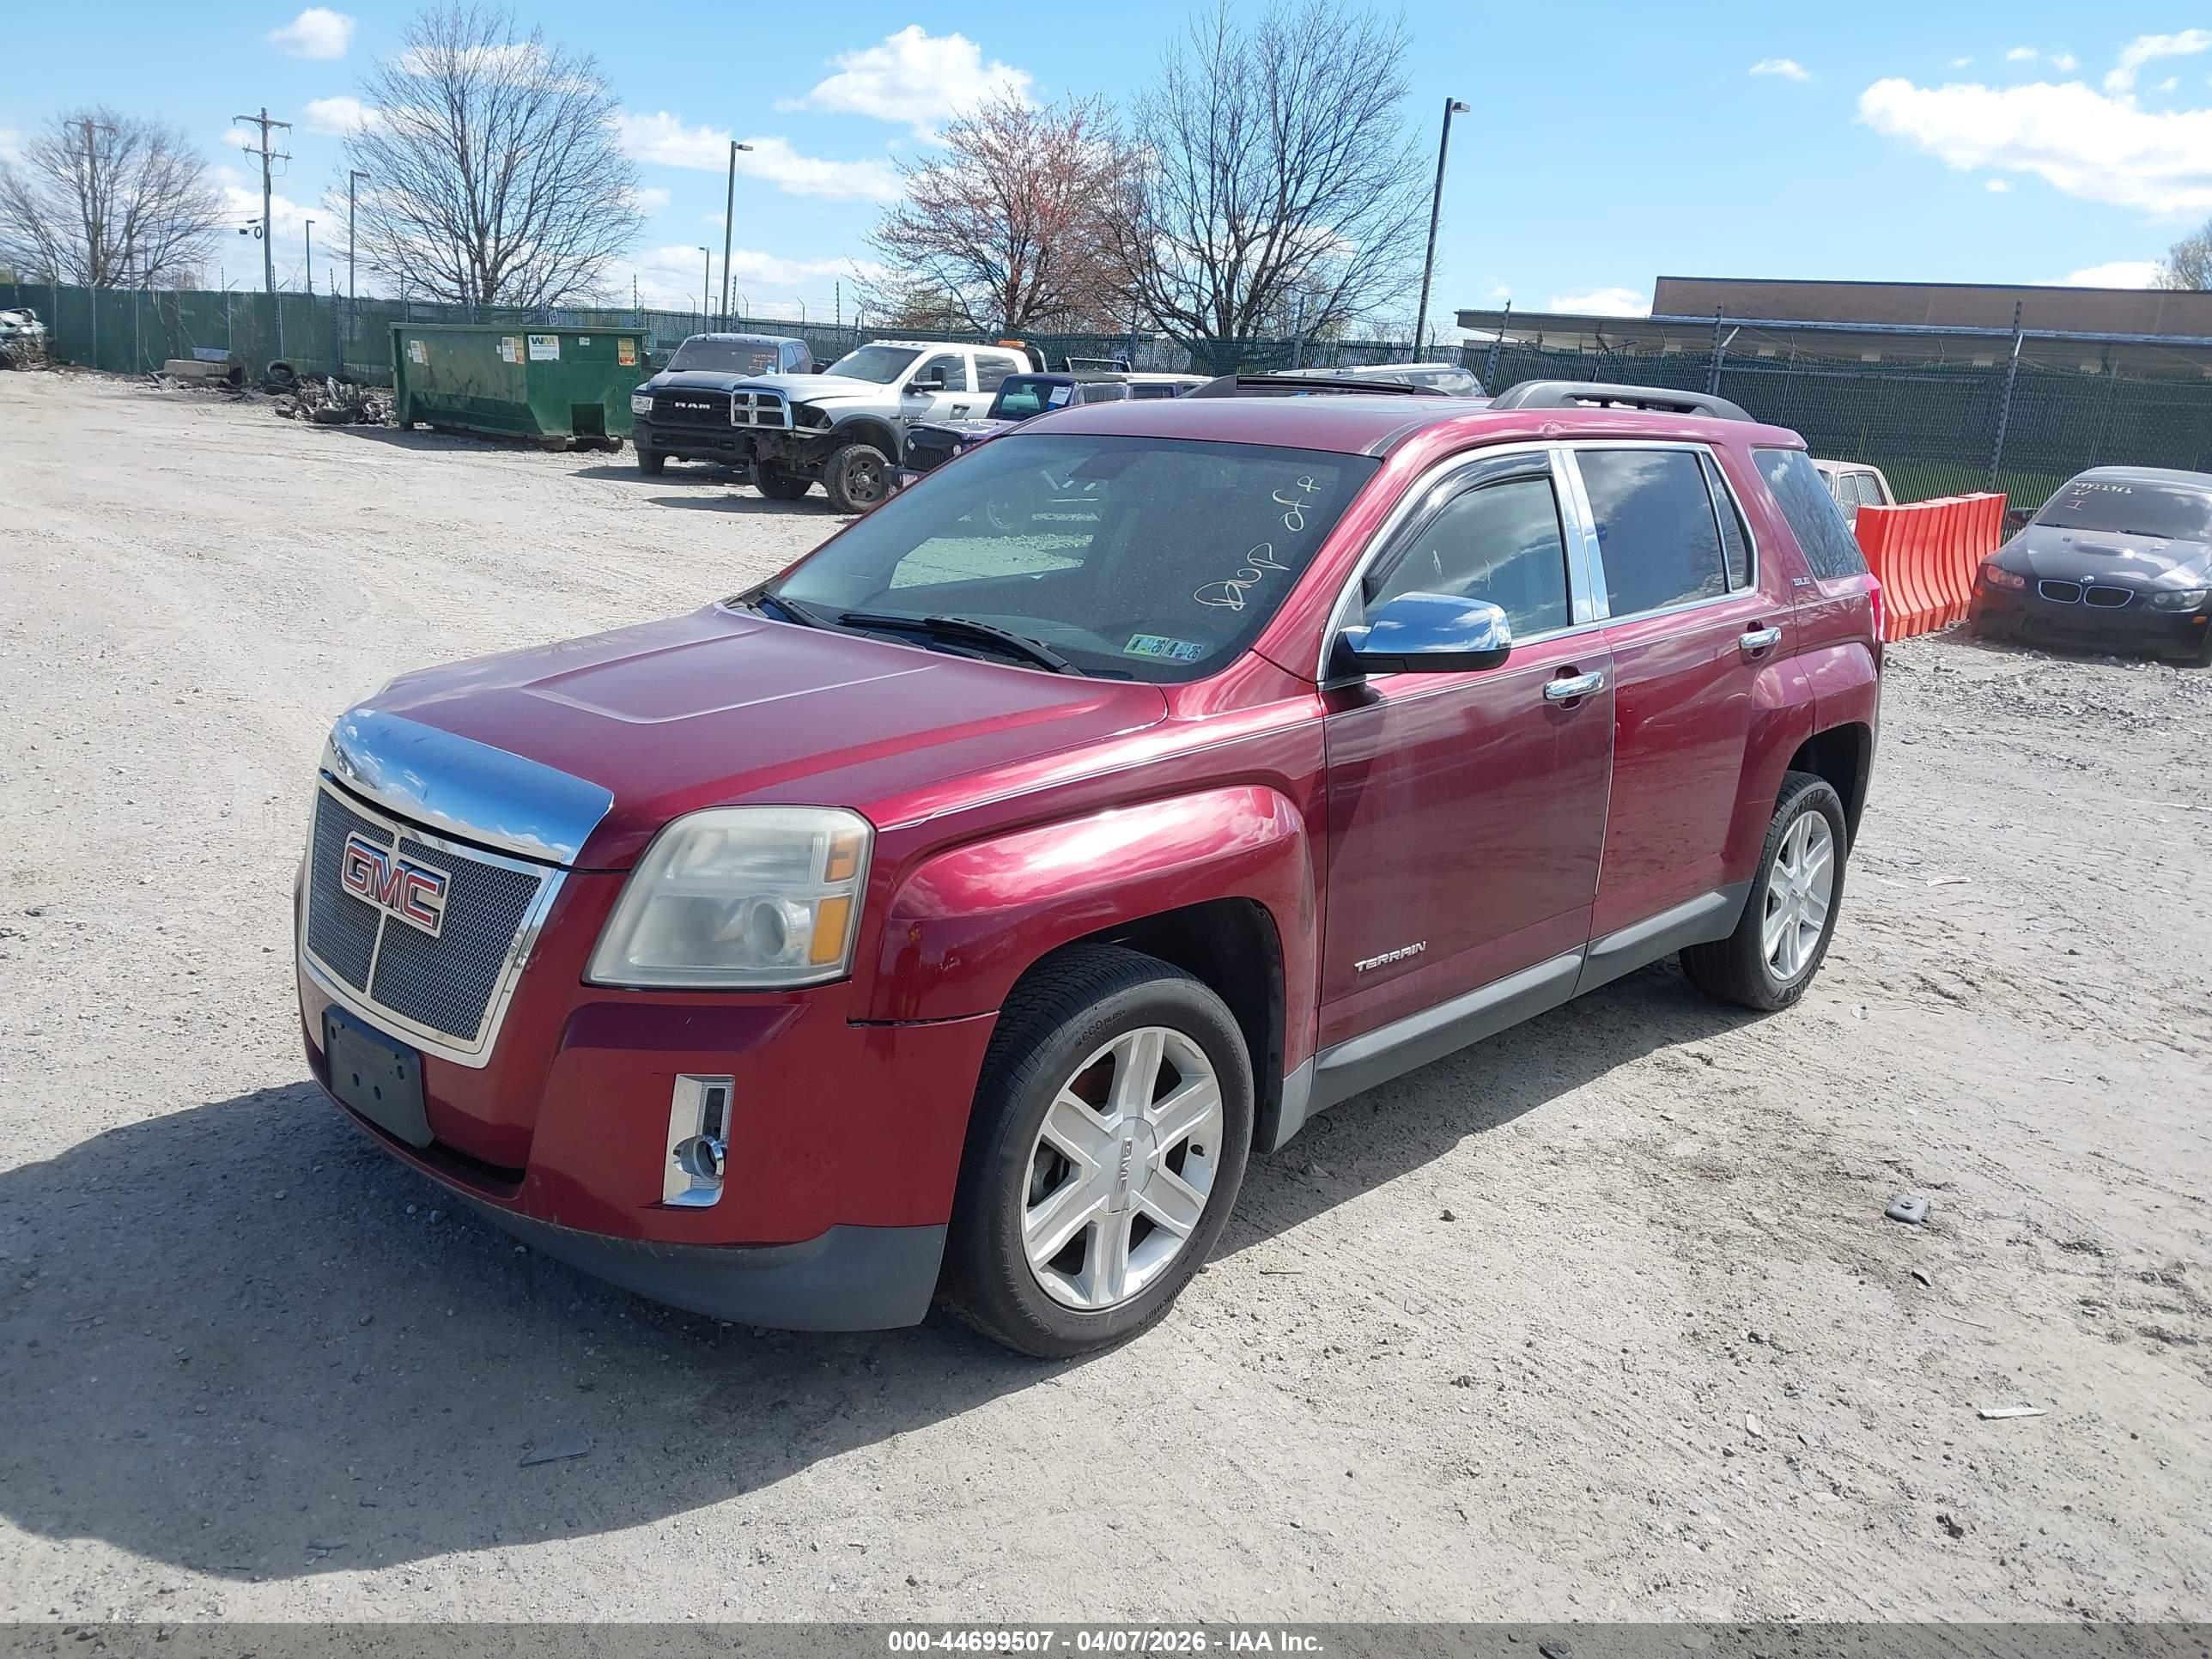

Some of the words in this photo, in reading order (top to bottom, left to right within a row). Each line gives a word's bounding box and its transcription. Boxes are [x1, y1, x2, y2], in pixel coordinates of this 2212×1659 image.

[674, 401, 711, 410] RAM
[1151, 640, 1165, 653] 26
[1187, 646, 1202, 659] 26
[343, 841, 446, 929] GMC
[1354, 941, 1426, 973] TERRAIN
